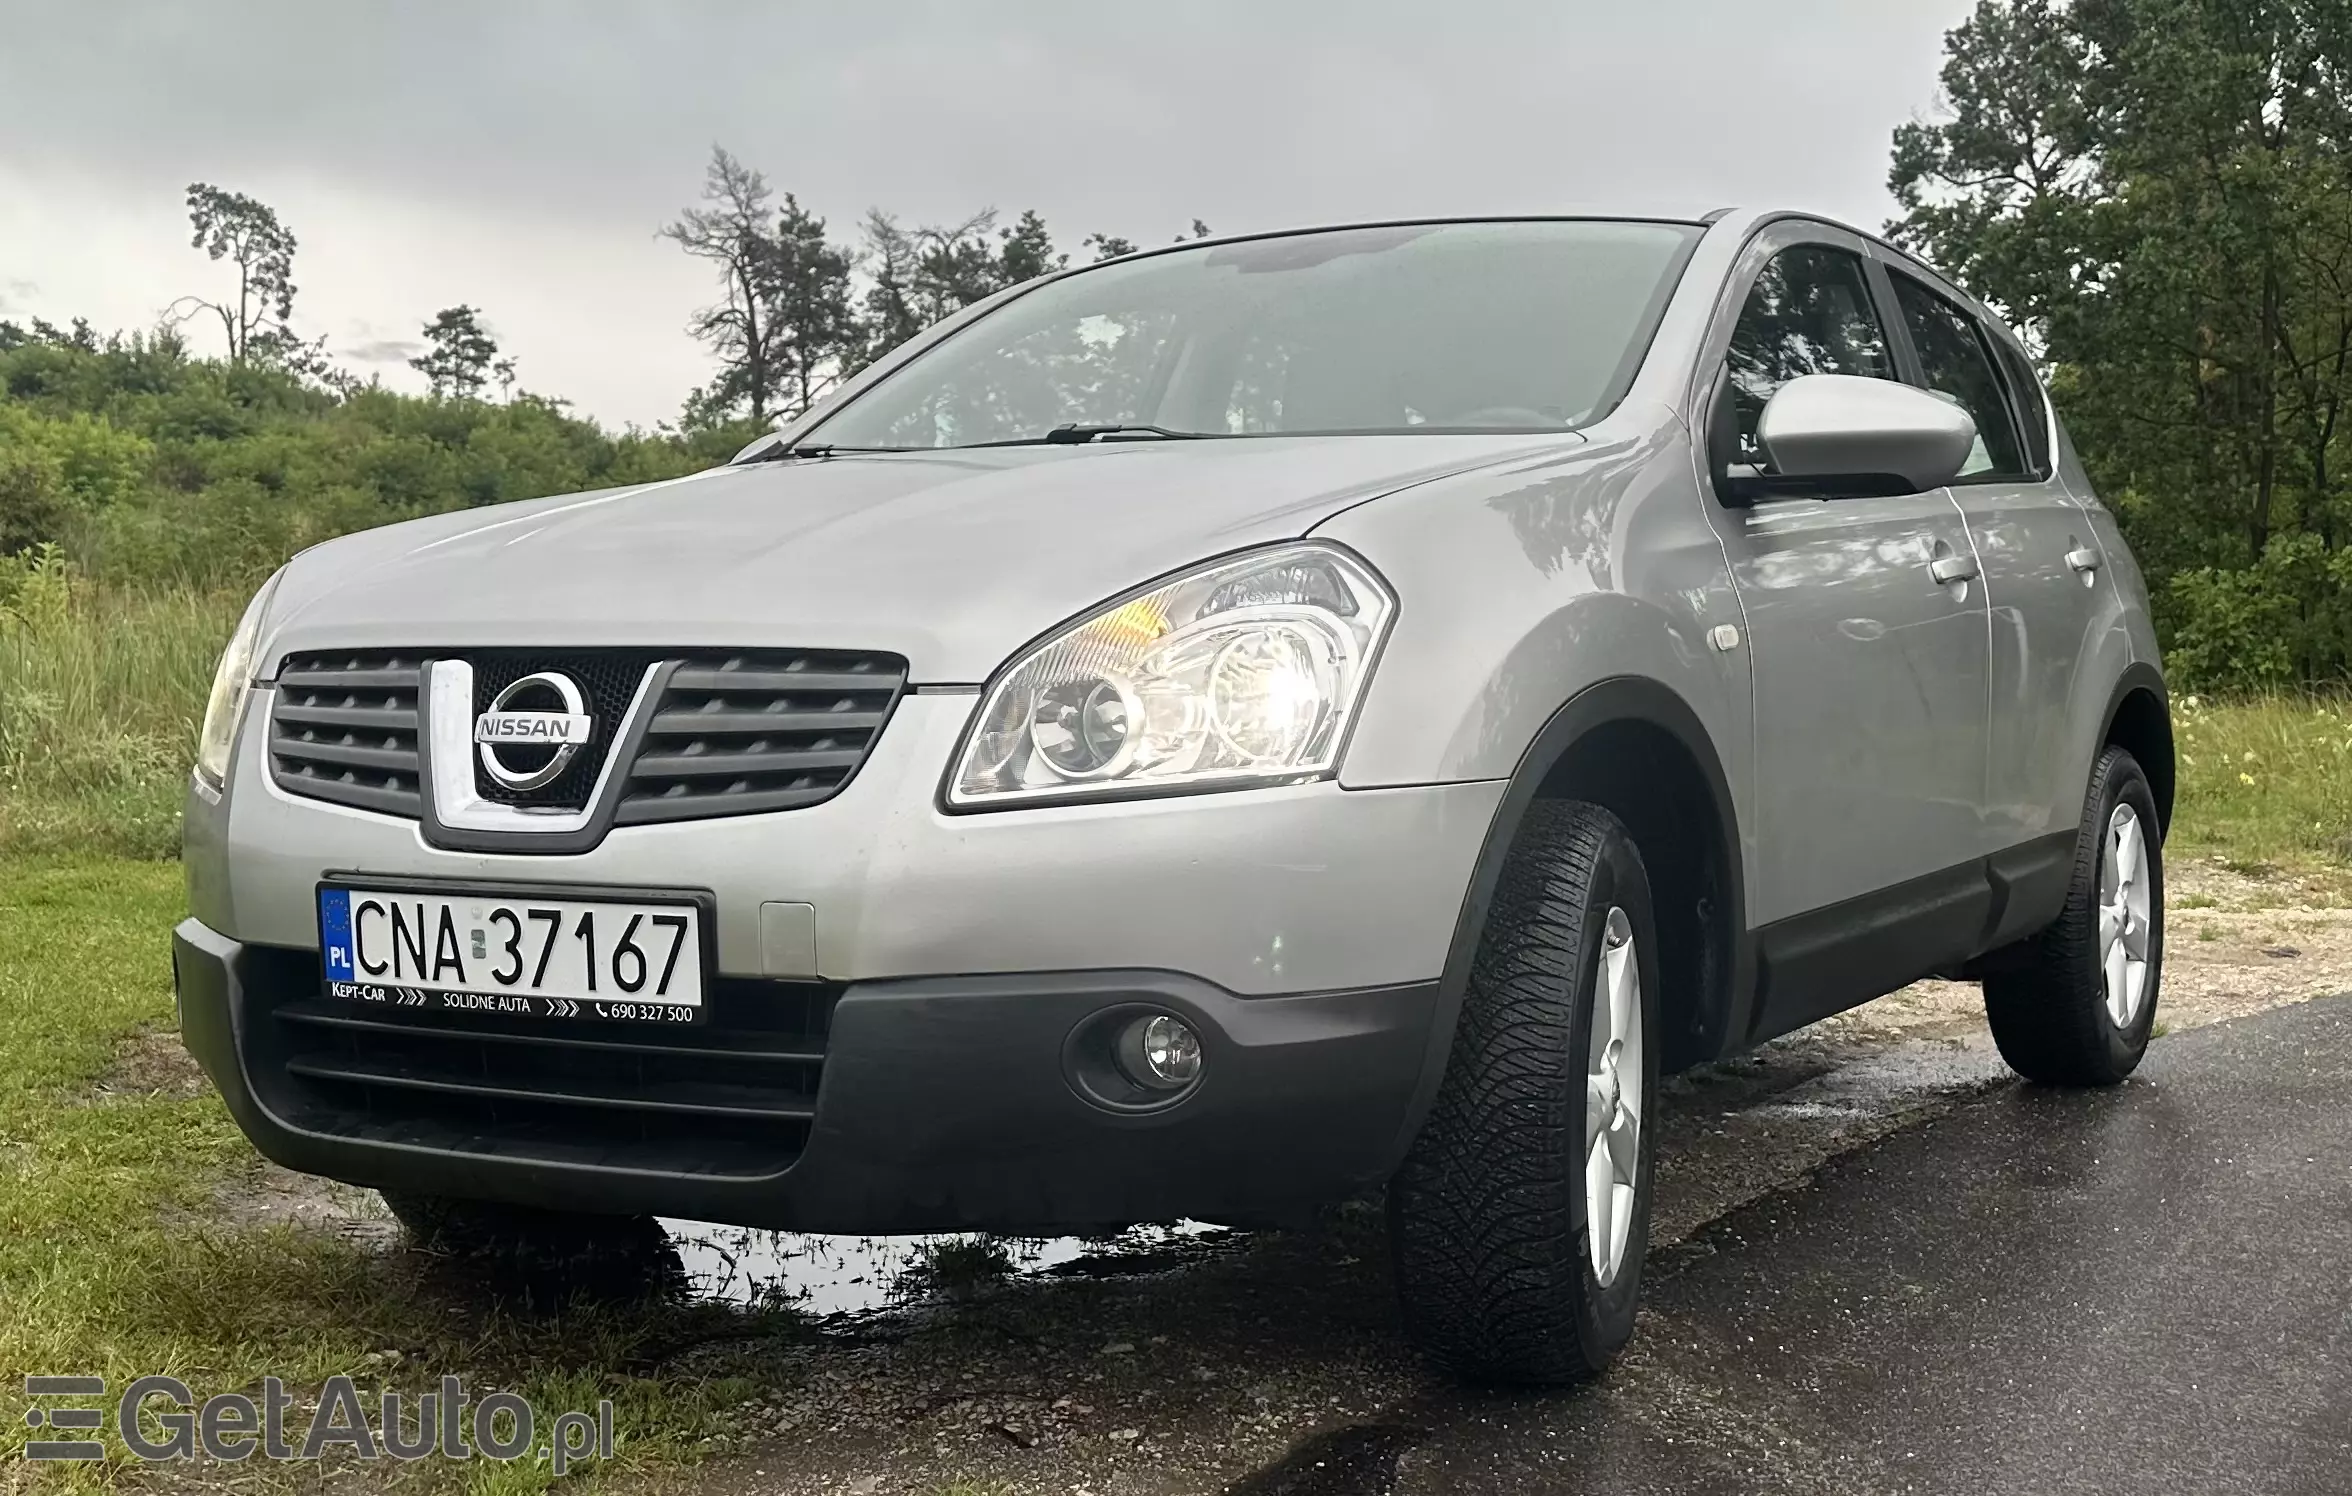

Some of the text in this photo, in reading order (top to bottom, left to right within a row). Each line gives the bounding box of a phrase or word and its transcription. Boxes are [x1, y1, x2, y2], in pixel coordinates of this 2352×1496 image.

[480, 718, 570, 737] NISSAN
[355, 900, 688, 995] CNA 37167
[331, 947, 350, 968] PL
[443, 994, 530, 1013] SOLIDNE AUTA
[611, 1005, 692, 1022] 690 327 500
